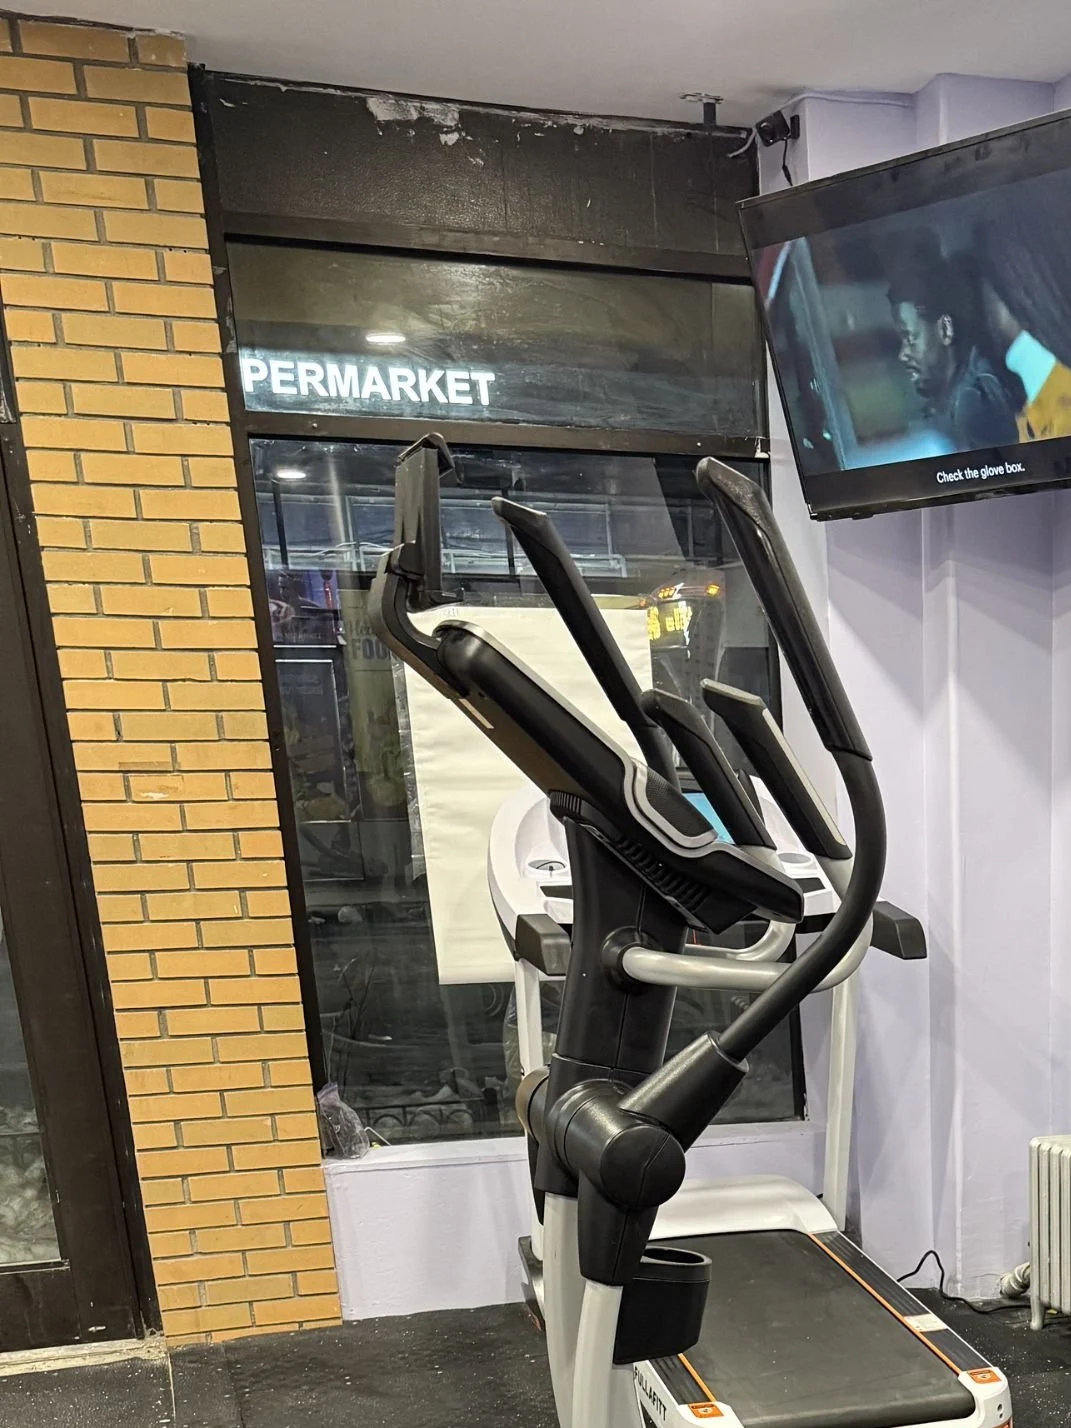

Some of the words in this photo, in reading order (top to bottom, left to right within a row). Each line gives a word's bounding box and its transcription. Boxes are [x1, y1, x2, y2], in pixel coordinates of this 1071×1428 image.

[241, 358, 496, 406] PERMARKET
[936, 469, 964, 483] Check
[964, 467, 979, 480] the
[980, 464, 1004, 480] glove
[1004, 461, 1026, 474] box.
